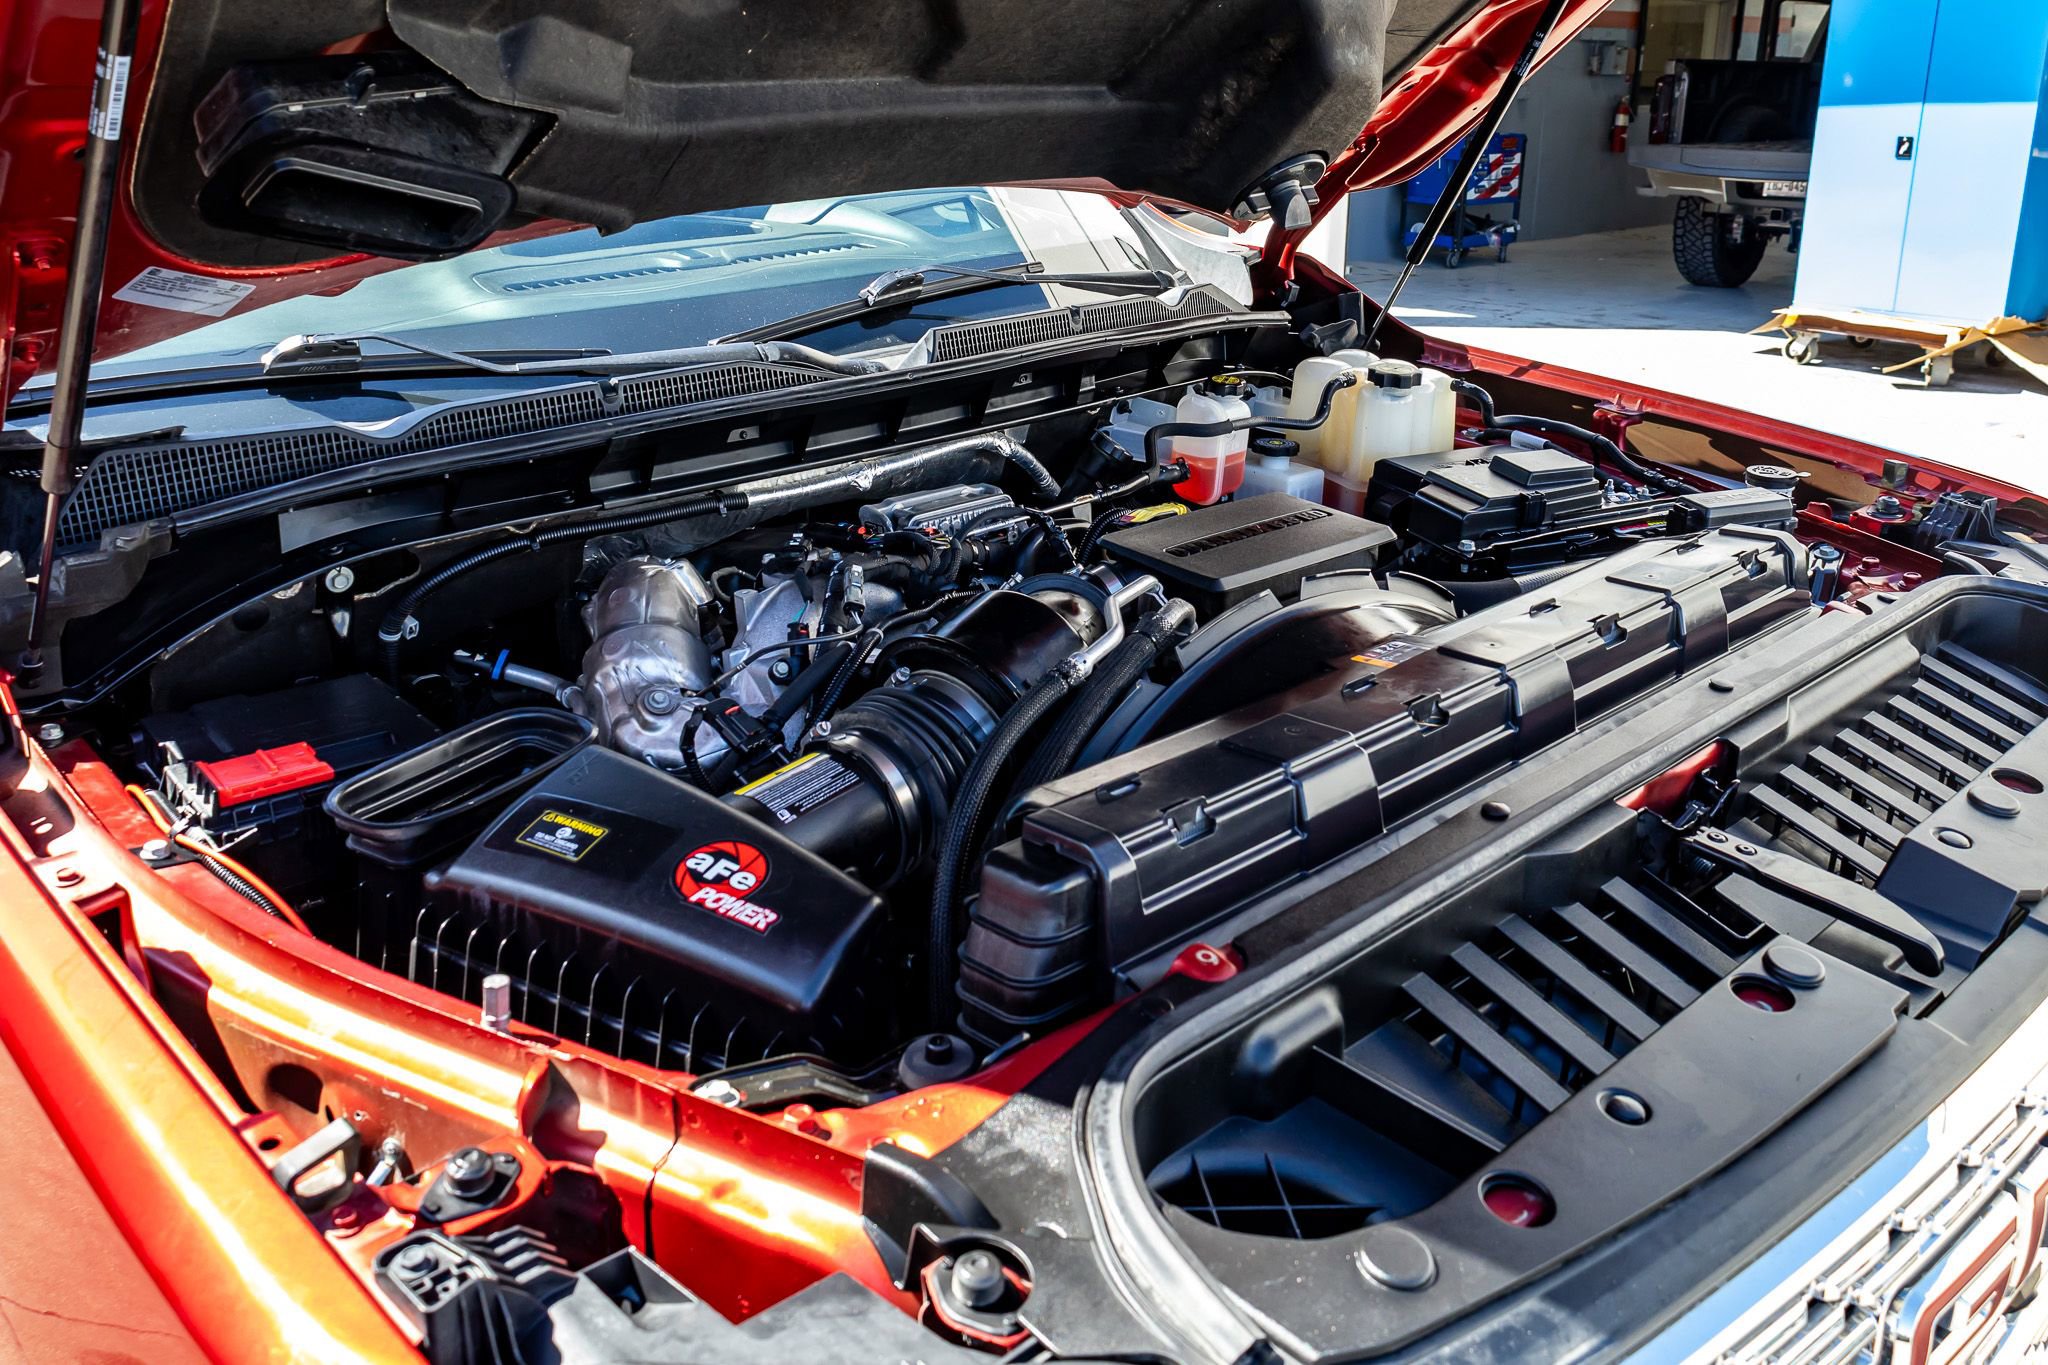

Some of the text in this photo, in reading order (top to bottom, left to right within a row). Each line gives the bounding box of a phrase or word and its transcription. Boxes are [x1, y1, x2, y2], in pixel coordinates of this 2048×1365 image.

[1302, 508, 1328, 522] HD
[554, 815, 604, 837] WARNING
[685, 852, 757, 891] aFe
[688, 886, 778, 930] POWER
